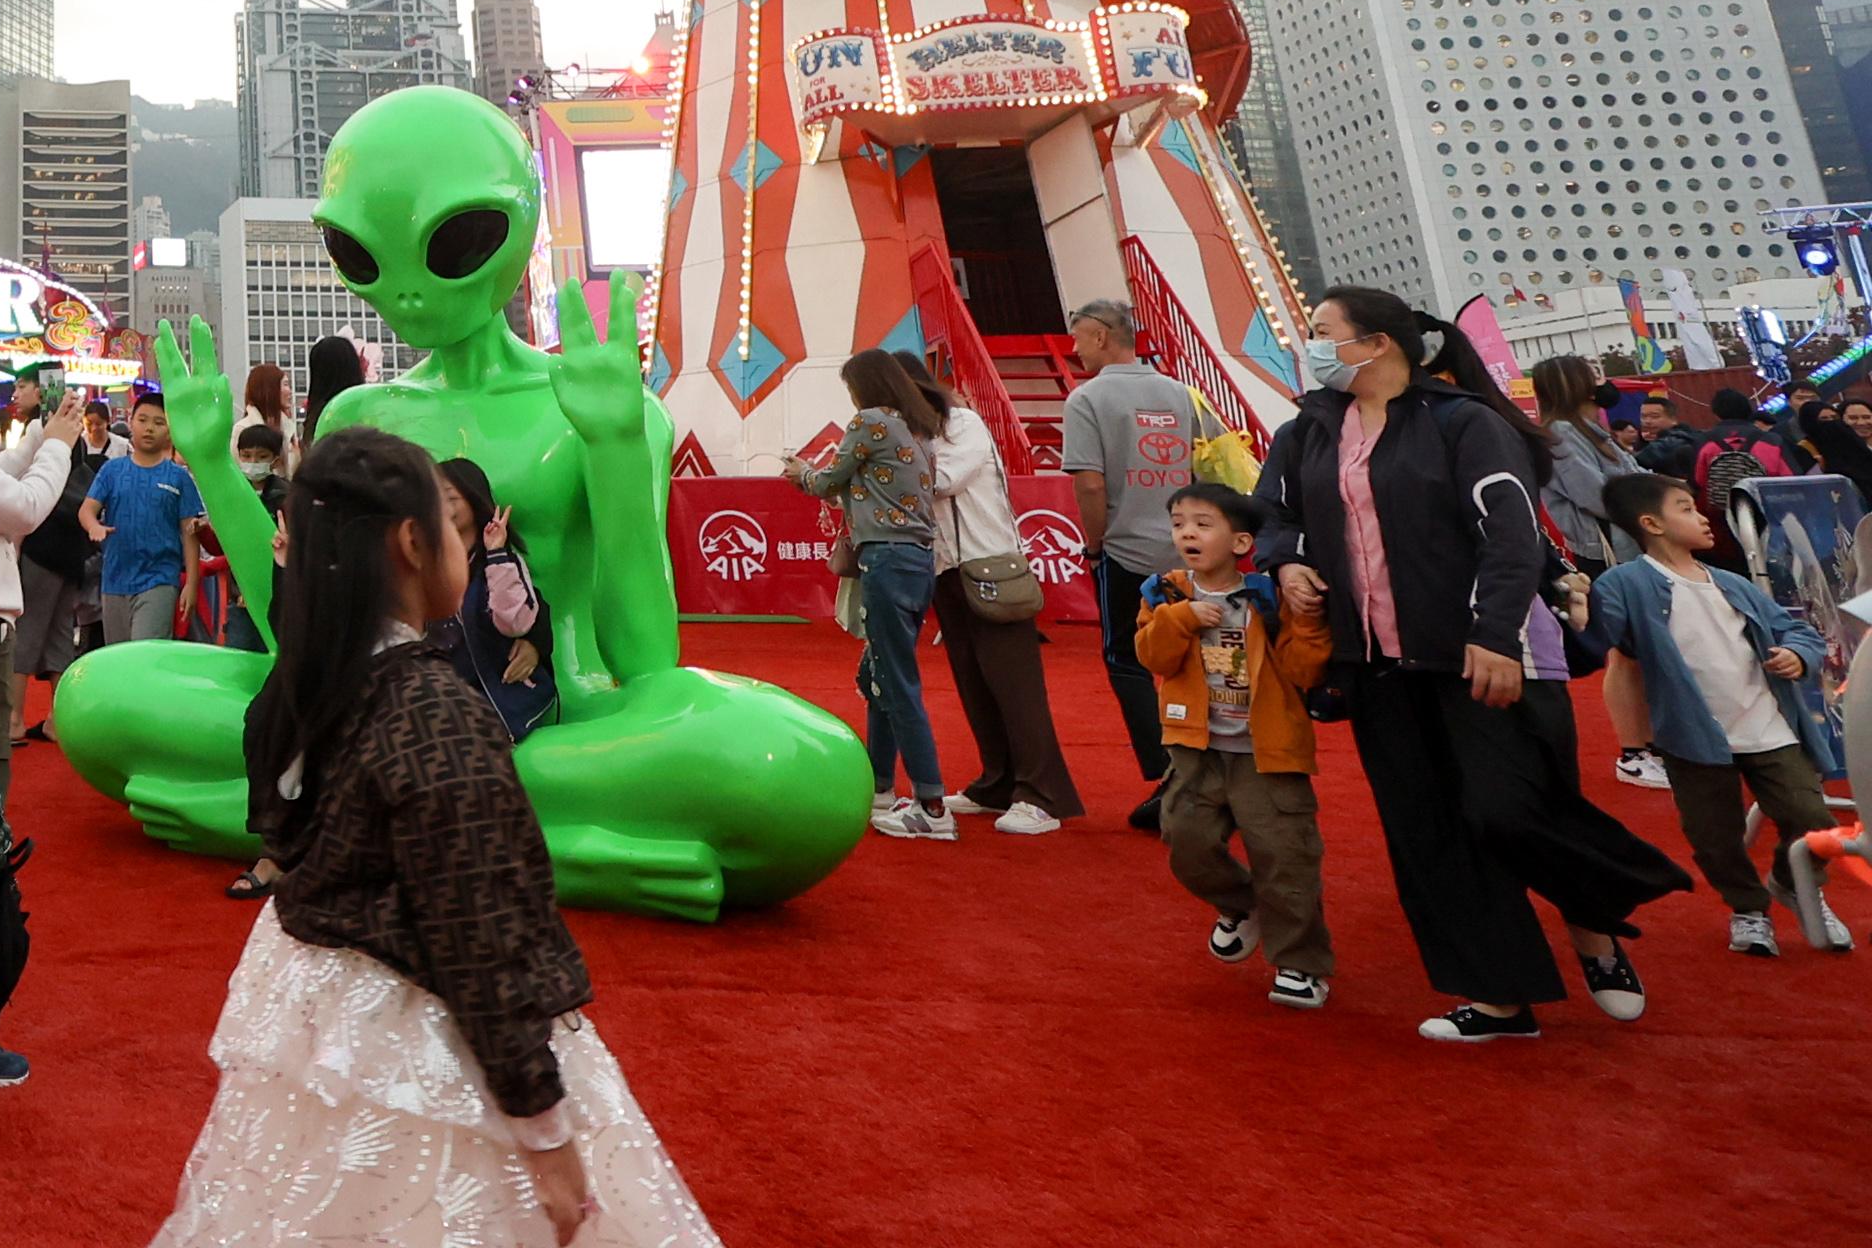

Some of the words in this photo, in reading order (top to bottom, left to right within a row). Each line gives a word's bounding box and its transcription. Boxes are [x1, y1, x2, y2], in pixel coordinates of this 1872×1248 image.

[810, 76, 826, 88] FOR
[905, 66, 1088, 102] SKELTER
[804, 84, 844, 112] ALL
[706, 555, 766, 581] AIA
[1029, 556, 1085, 584] AIA
